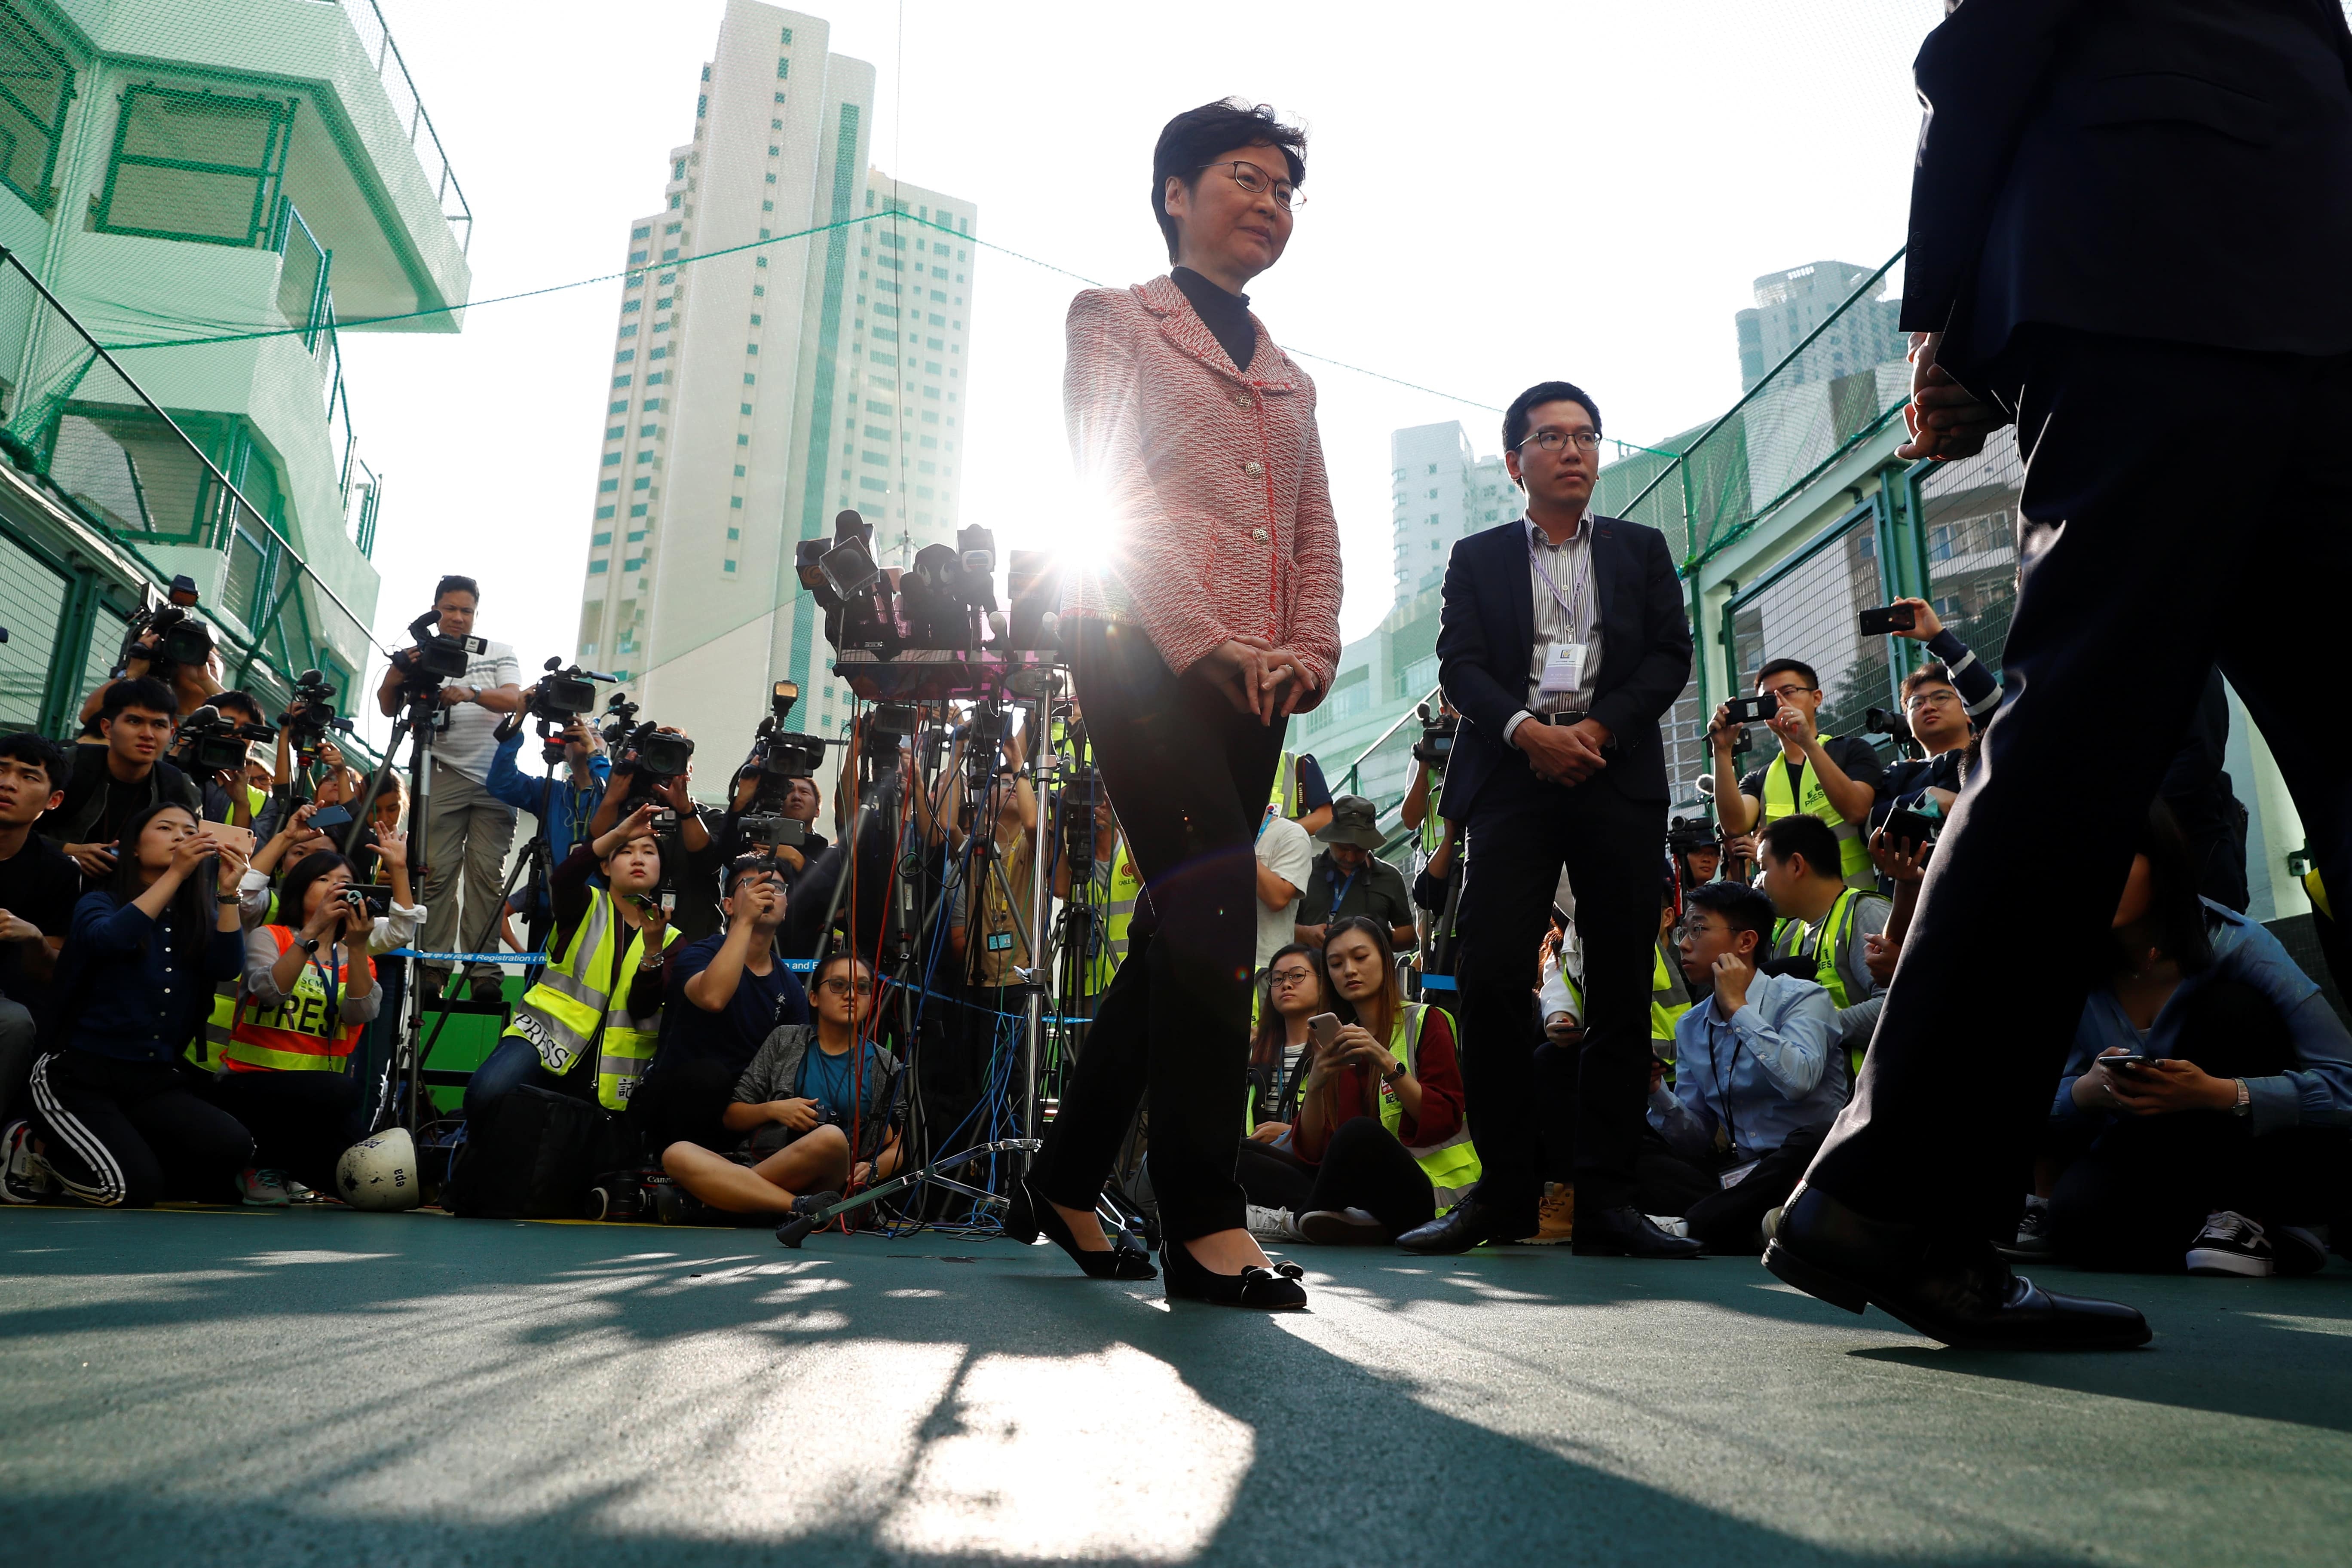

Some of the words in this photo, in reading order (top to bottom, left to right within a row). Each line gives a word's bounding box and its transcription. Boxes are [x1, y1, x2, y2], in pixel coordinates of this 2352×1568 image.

[476, 954, 530, 962] Registration
[301, 977, 323, 988] SCM
[254, 995, 339, 1037] PRES
[618, 1078, 634, 1099] 記
[394, 1168, 407, 1187] epa
